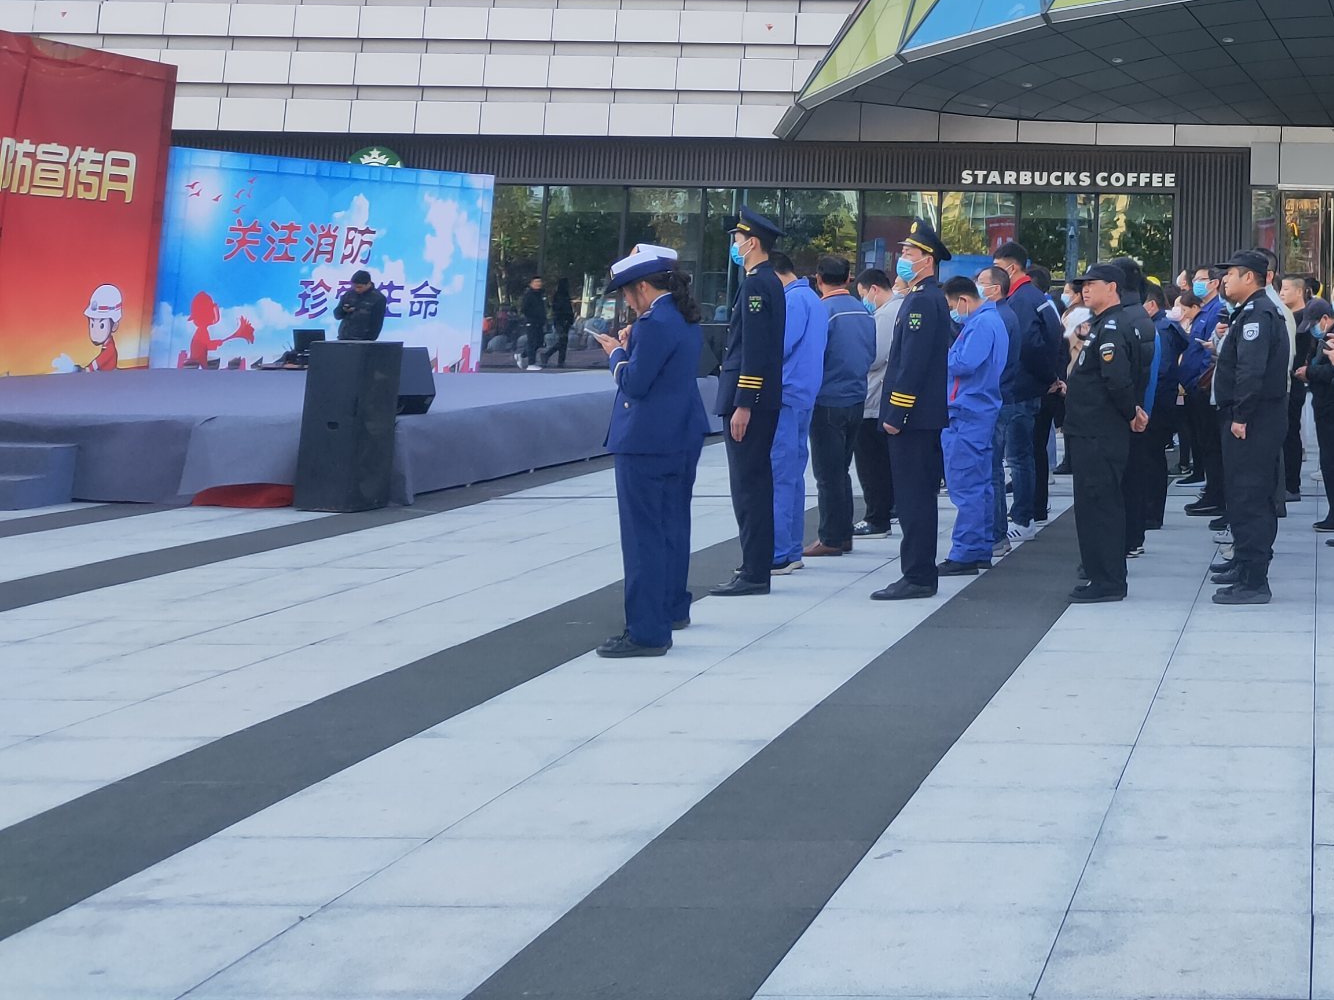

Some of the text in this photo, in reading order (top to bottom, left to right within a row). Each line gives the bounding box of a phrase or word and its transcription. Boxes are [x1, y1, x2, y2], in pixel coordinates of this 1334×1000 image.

[0, 137, 137, 204] 防宣传月
[961, 169, 1176, 187] STARBUCKS COFFEE
[223, 218, 378, 266] 关注消防
[294, 278, 443, 320] 珍生命
